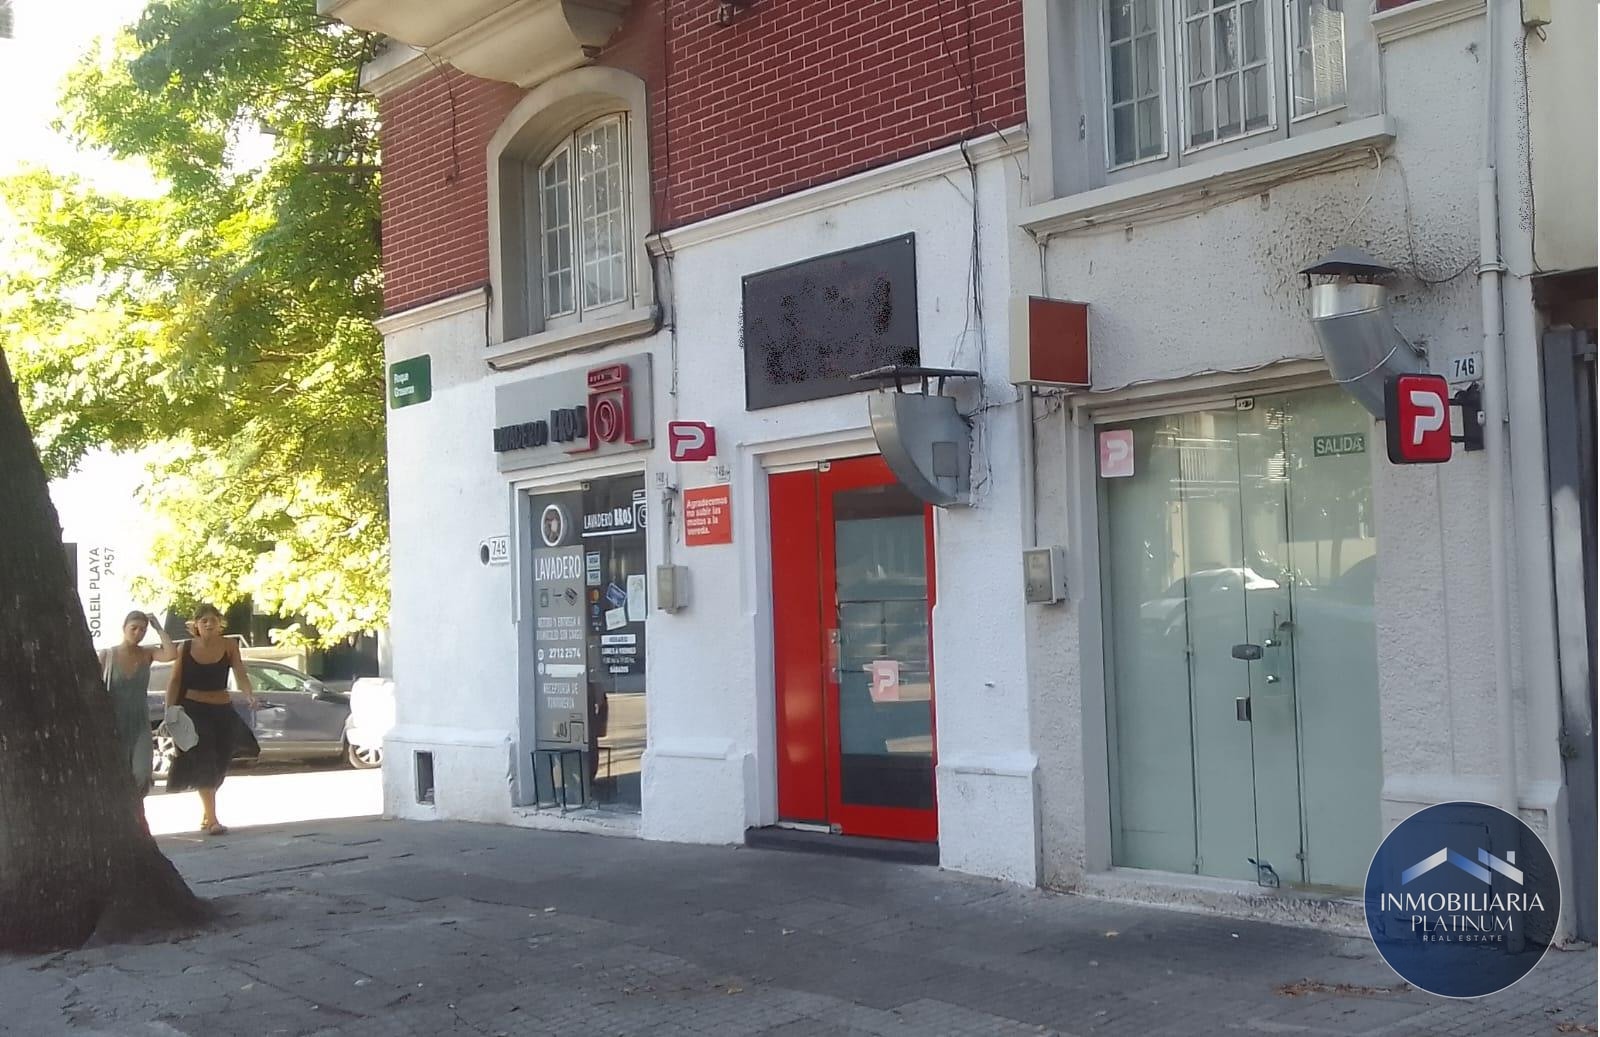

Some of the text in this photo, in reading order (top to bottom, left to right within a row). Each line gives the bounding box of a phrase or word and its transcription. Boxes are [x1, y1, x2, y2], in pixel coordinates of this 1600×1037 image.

[1454, 358, 1475, 377] 746
[1315, 436, 1364, 455] SALIDA
[686, 496, 728, 510] Agradecemos
[584, 506, 632, 529] LAVADERO BROS
[686, 510, 696, 518] no
[696, 507, 711, 517] subir
[686, 518, 706, 526] motos
[492, 540, 507, 555] 748
[535, 556, 581, 581] LAVADERO
[89, 547, 101, 638] SOLEIL PLAYA
[549, 647, 581, 659] 2712 2574
